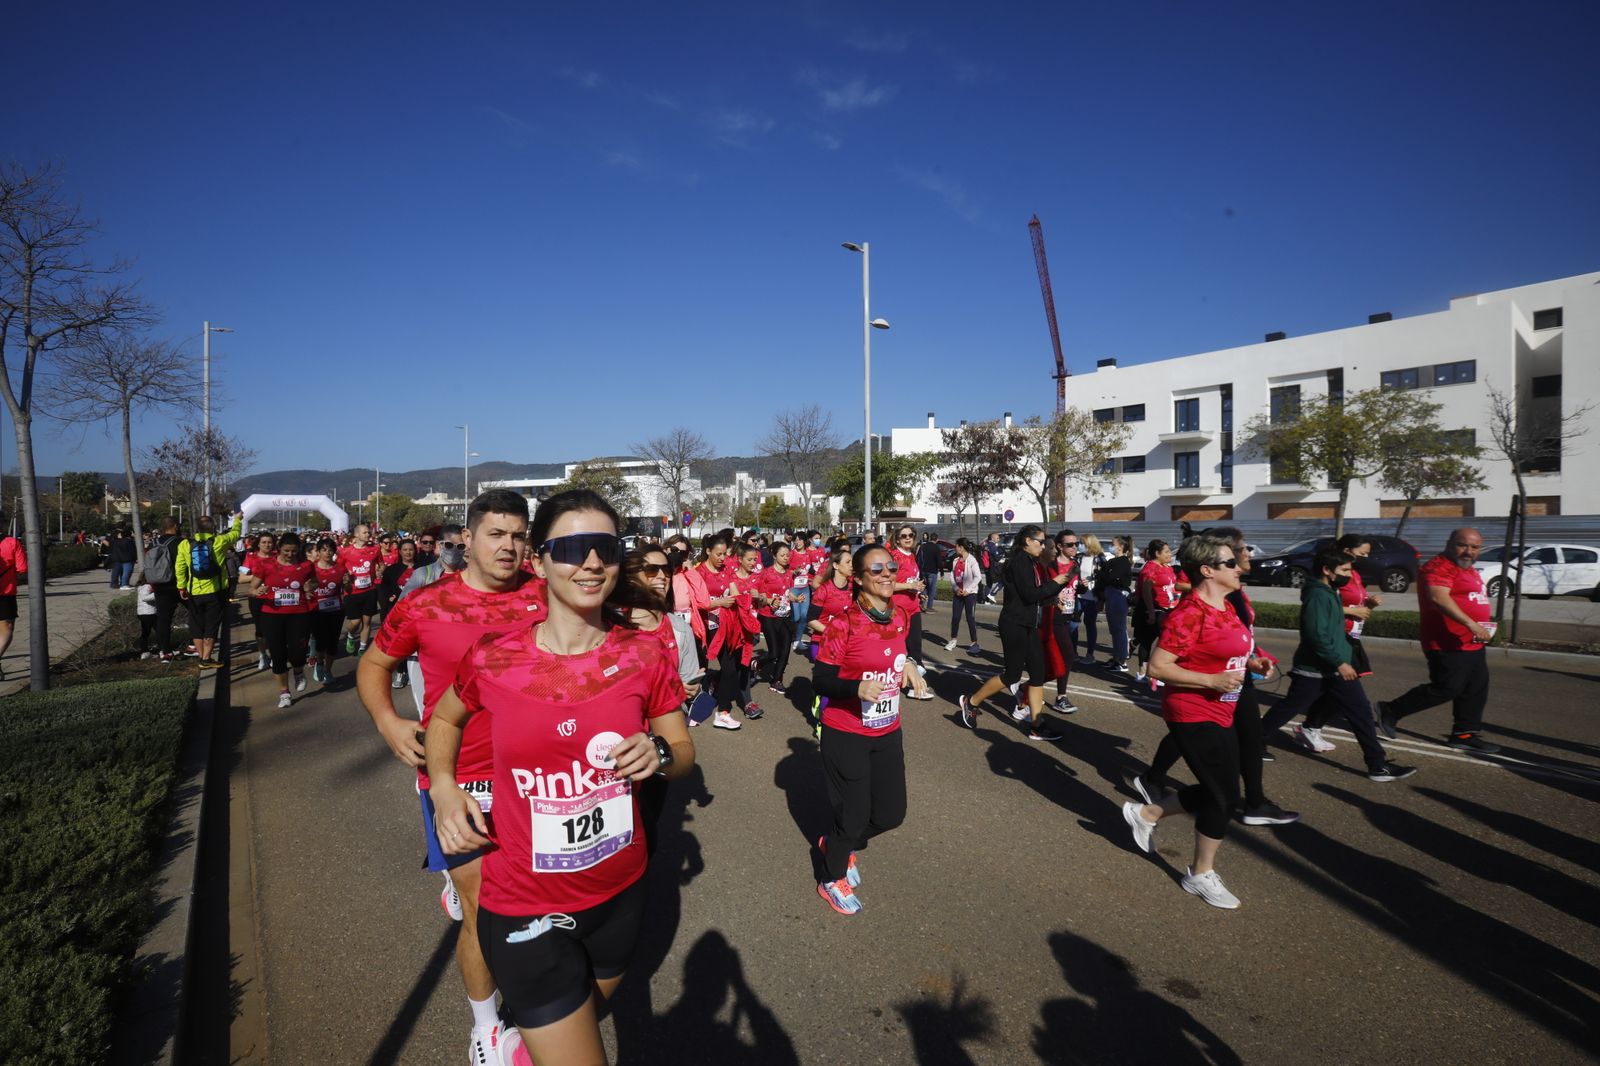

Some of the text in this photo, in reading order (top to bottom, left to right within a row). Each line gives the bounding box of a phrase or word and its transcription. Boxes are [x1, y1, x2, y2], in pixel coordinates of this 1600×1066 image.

[875, 699, 892, 714] 421
[511, 760, 597, 799] Pink
[562, 807, 605, 844] 128
